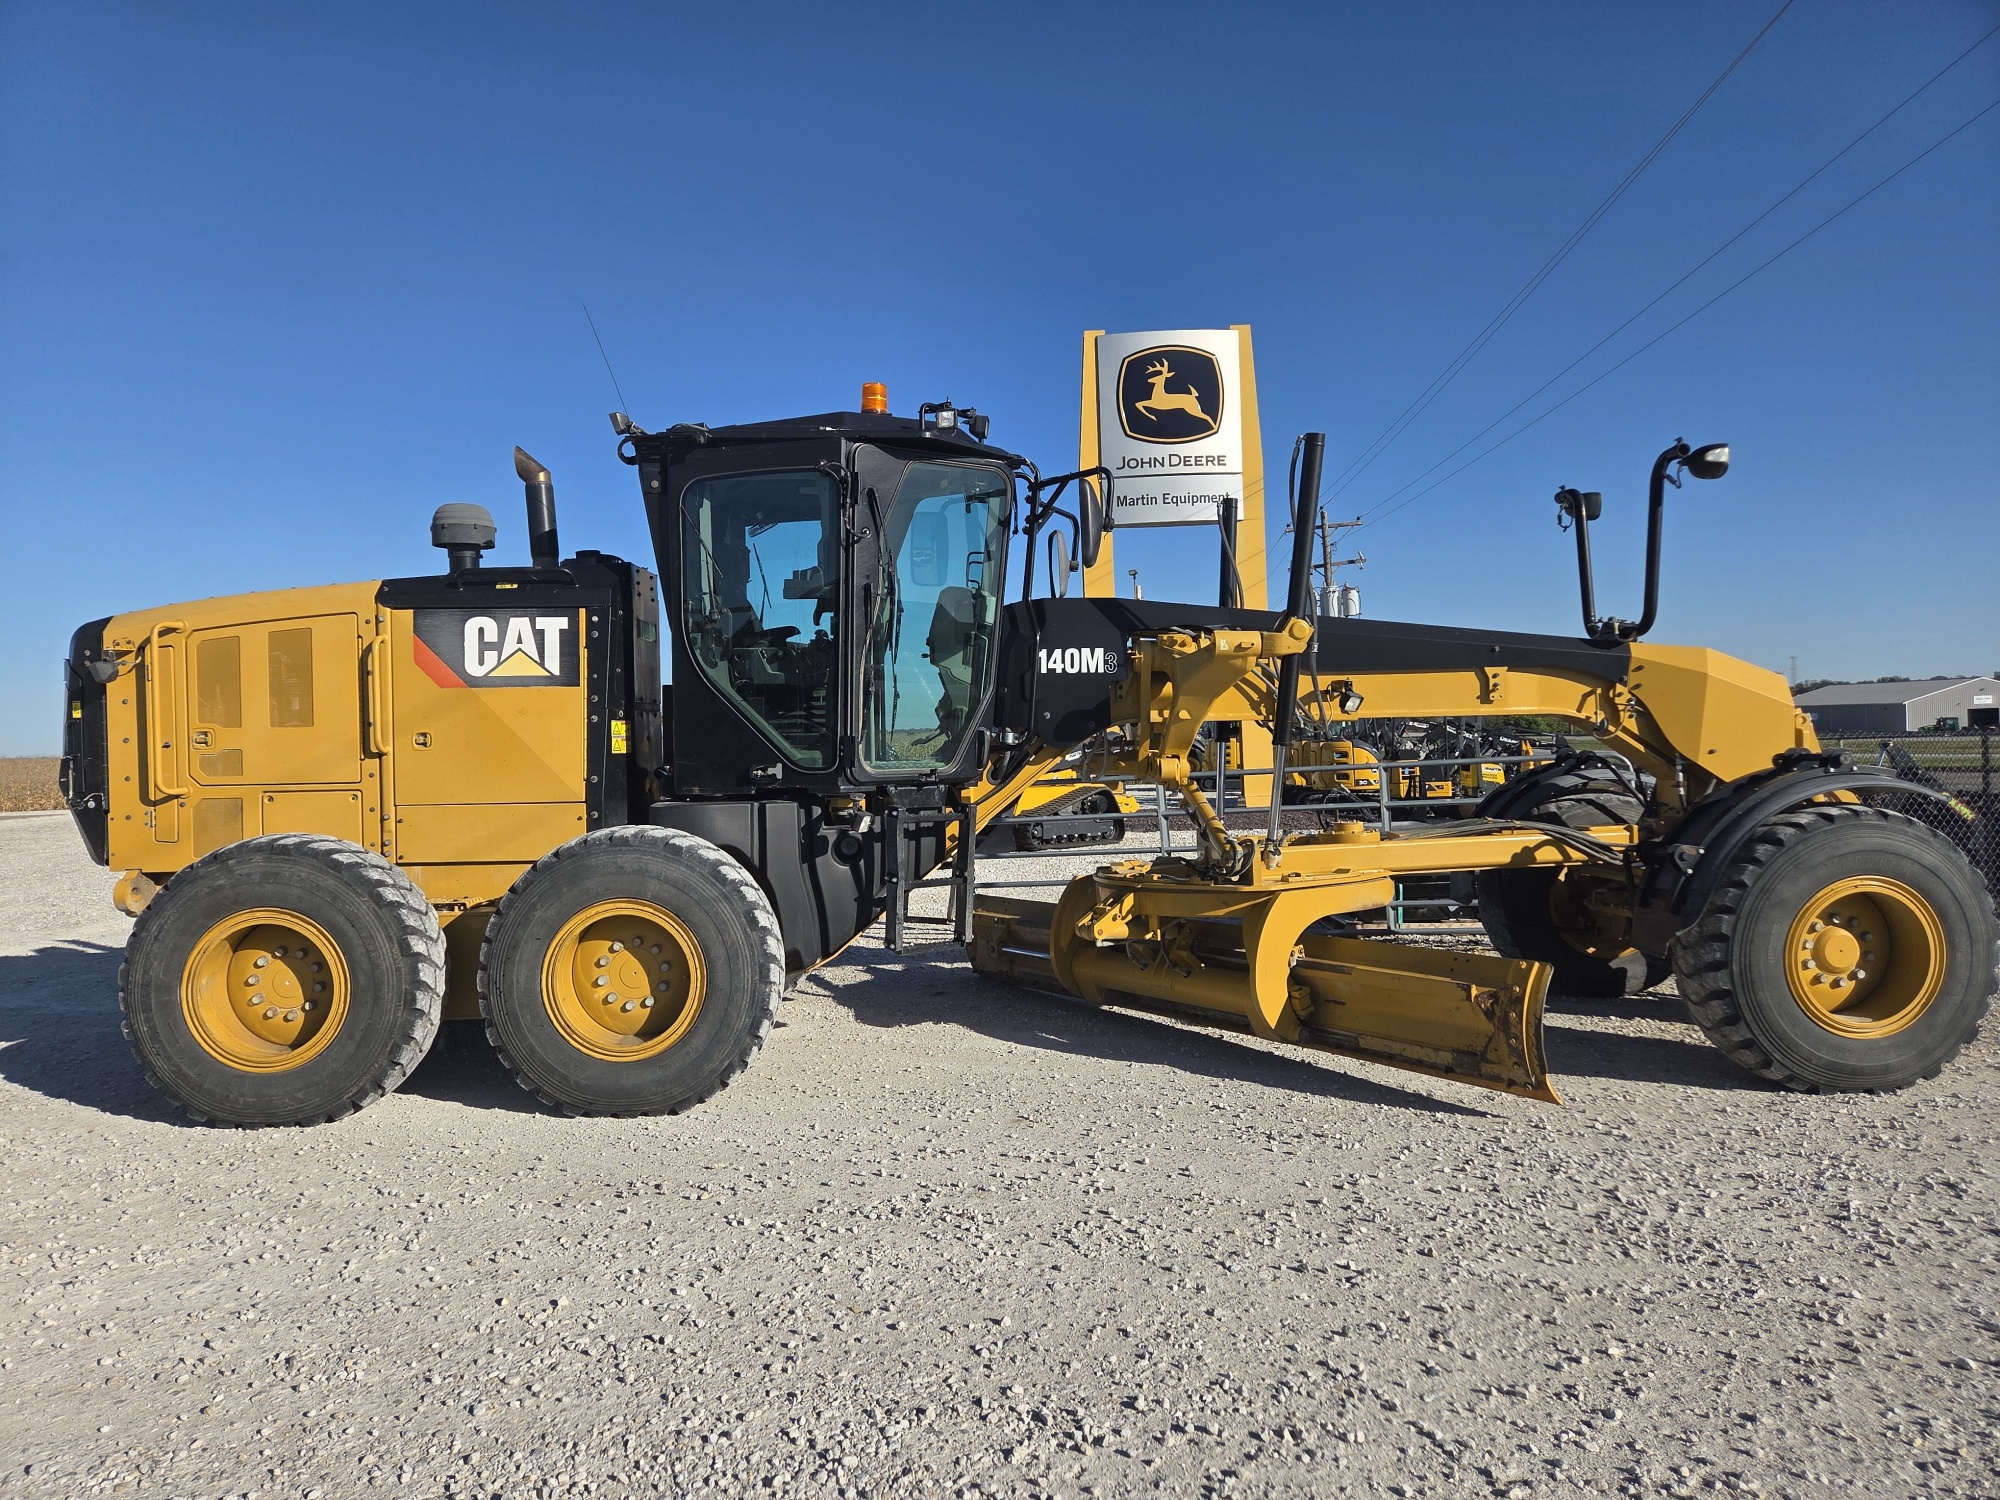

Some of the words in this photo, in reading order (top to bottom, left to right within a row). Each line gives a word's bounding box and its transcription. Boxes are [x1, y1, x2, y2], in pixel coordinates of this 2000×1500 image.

[1116, 456, 1165, 470] JOHN
[1168, 454, 1227, 467] DEERE
[1116, 494, 1158, 507] Martin
[464, 616, 569, 677] CAT
